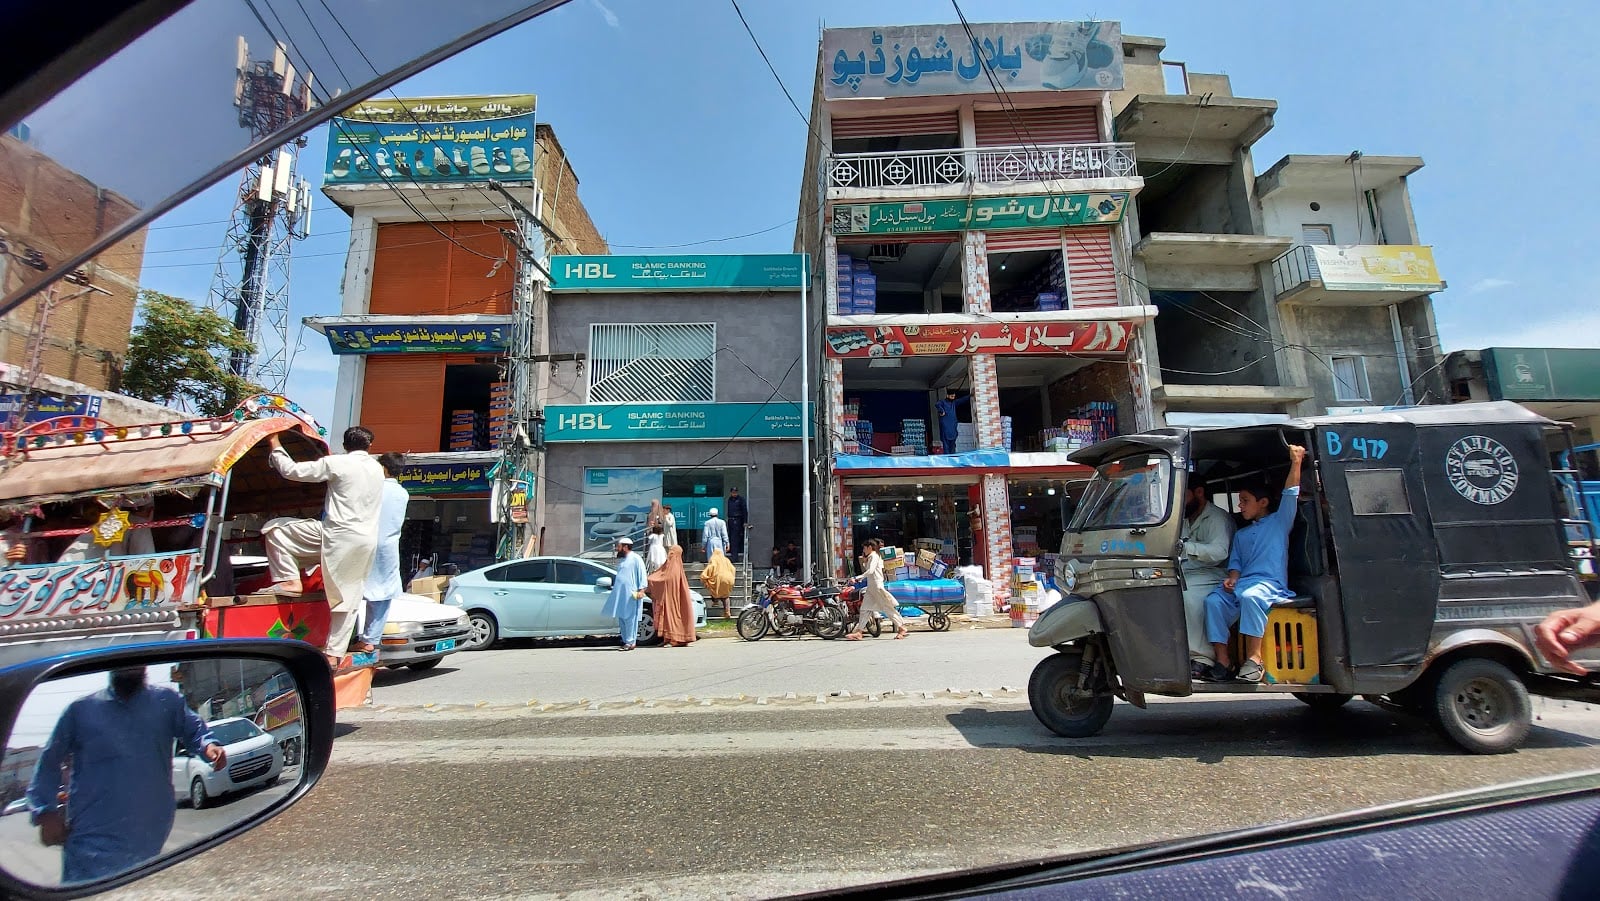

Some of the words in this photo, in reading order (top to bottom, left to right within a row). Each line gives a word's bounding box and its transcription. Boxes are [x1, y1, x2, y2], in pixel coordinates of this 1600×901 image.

[830, 31, 886, 92] ڈپو
[886, 35, 954, 85] شوز
[956, 34, 1022, 80] بلال
[380, 128, 419, 146] کمپنی
[419, 126, 444, 144] شوز
[490, 126, 527, 140] عوامی
[959, 198, 1026, 223] شوز
[1028, 196, 1082, 220] بلال
[565, 263, 617, 280] HBL
[632, 262, 666, 270] ISLAMIC
[371, 329, 402, 345] کمپنی
[402, 328, 420, 344] شوز
[460, 329, 487, 344] عوامی
[954, 325, 1012, 353] شوز
[1014, 325, 1075, 353] بلال
[558, 413, 612, 430] HBL
[1326, 432, 1342, 456] B
[1352, 438, 1388, 459] 479
[1448, 437, 1513, 466] STAHLCO
[452, 467, 480, 480] عوامی
[1438, 606, 1493, 619] STAHLCO
